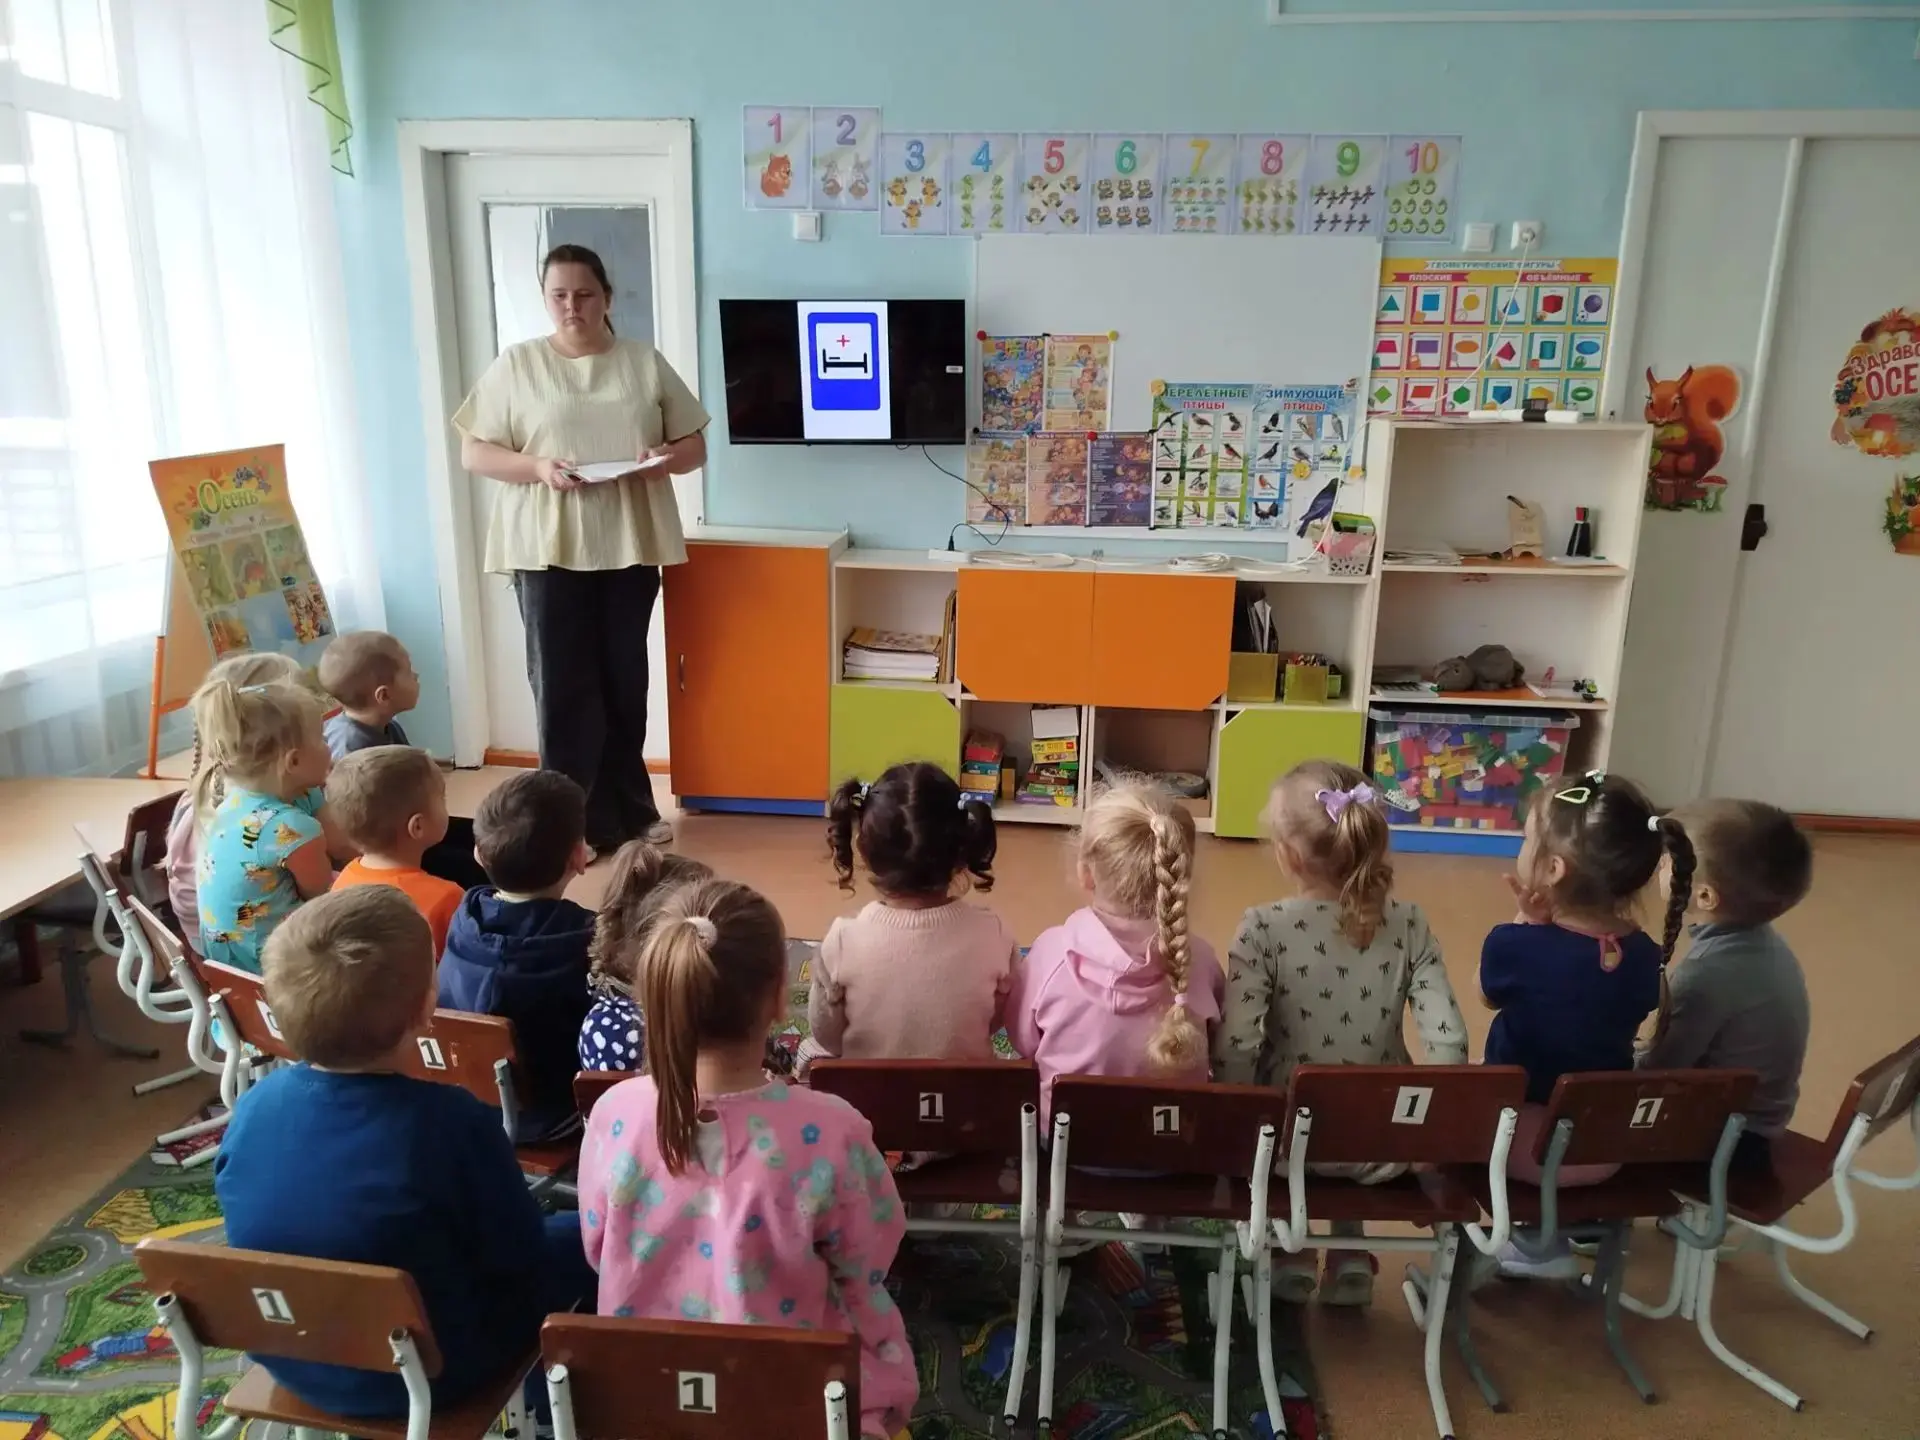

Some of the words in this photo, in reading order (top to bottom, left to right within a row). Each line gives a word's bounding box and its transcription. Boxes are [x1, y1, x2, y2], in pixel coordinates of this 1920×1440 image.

[767, 113, 782, 144] 1
[836, 114, 857, 146] 2
[904, 140, 925, 173] 3
[970, 140, 993, 173] 4
[1043, 140, 1065, 175] 5
[1114, 140, 1137, 174] 6
[1189, 139, 1211, 175] 7
[1260, 140, 1284, 175] 8
[1336, 141, 1361, 176] 9
[1405, 141, 1440, 174] 10
[1431, 261, 1515, 269] ГЕОМЕТРИЧЕСКИЕ
[1183, 401, 1225, 410] ПТИЦЫ
[1266, 389, 1345, 400] ЗИМУЮЩИЕ
[1283, 402, 1326, 411] ПТИЦЫ
[199, 480, 259, 514] Осень
[420, 1040, 444, 1068] 1
[921, 1093, 944, 1120] 1
[1155, 1108, 1179, 1135] 1
[1402, 1094, 1421, 1118] 1
[1631, 1100, 1656, 1127] 1
[256, 1291, 292, 1322] 1
[681, 1376, 714, 1412] 1
